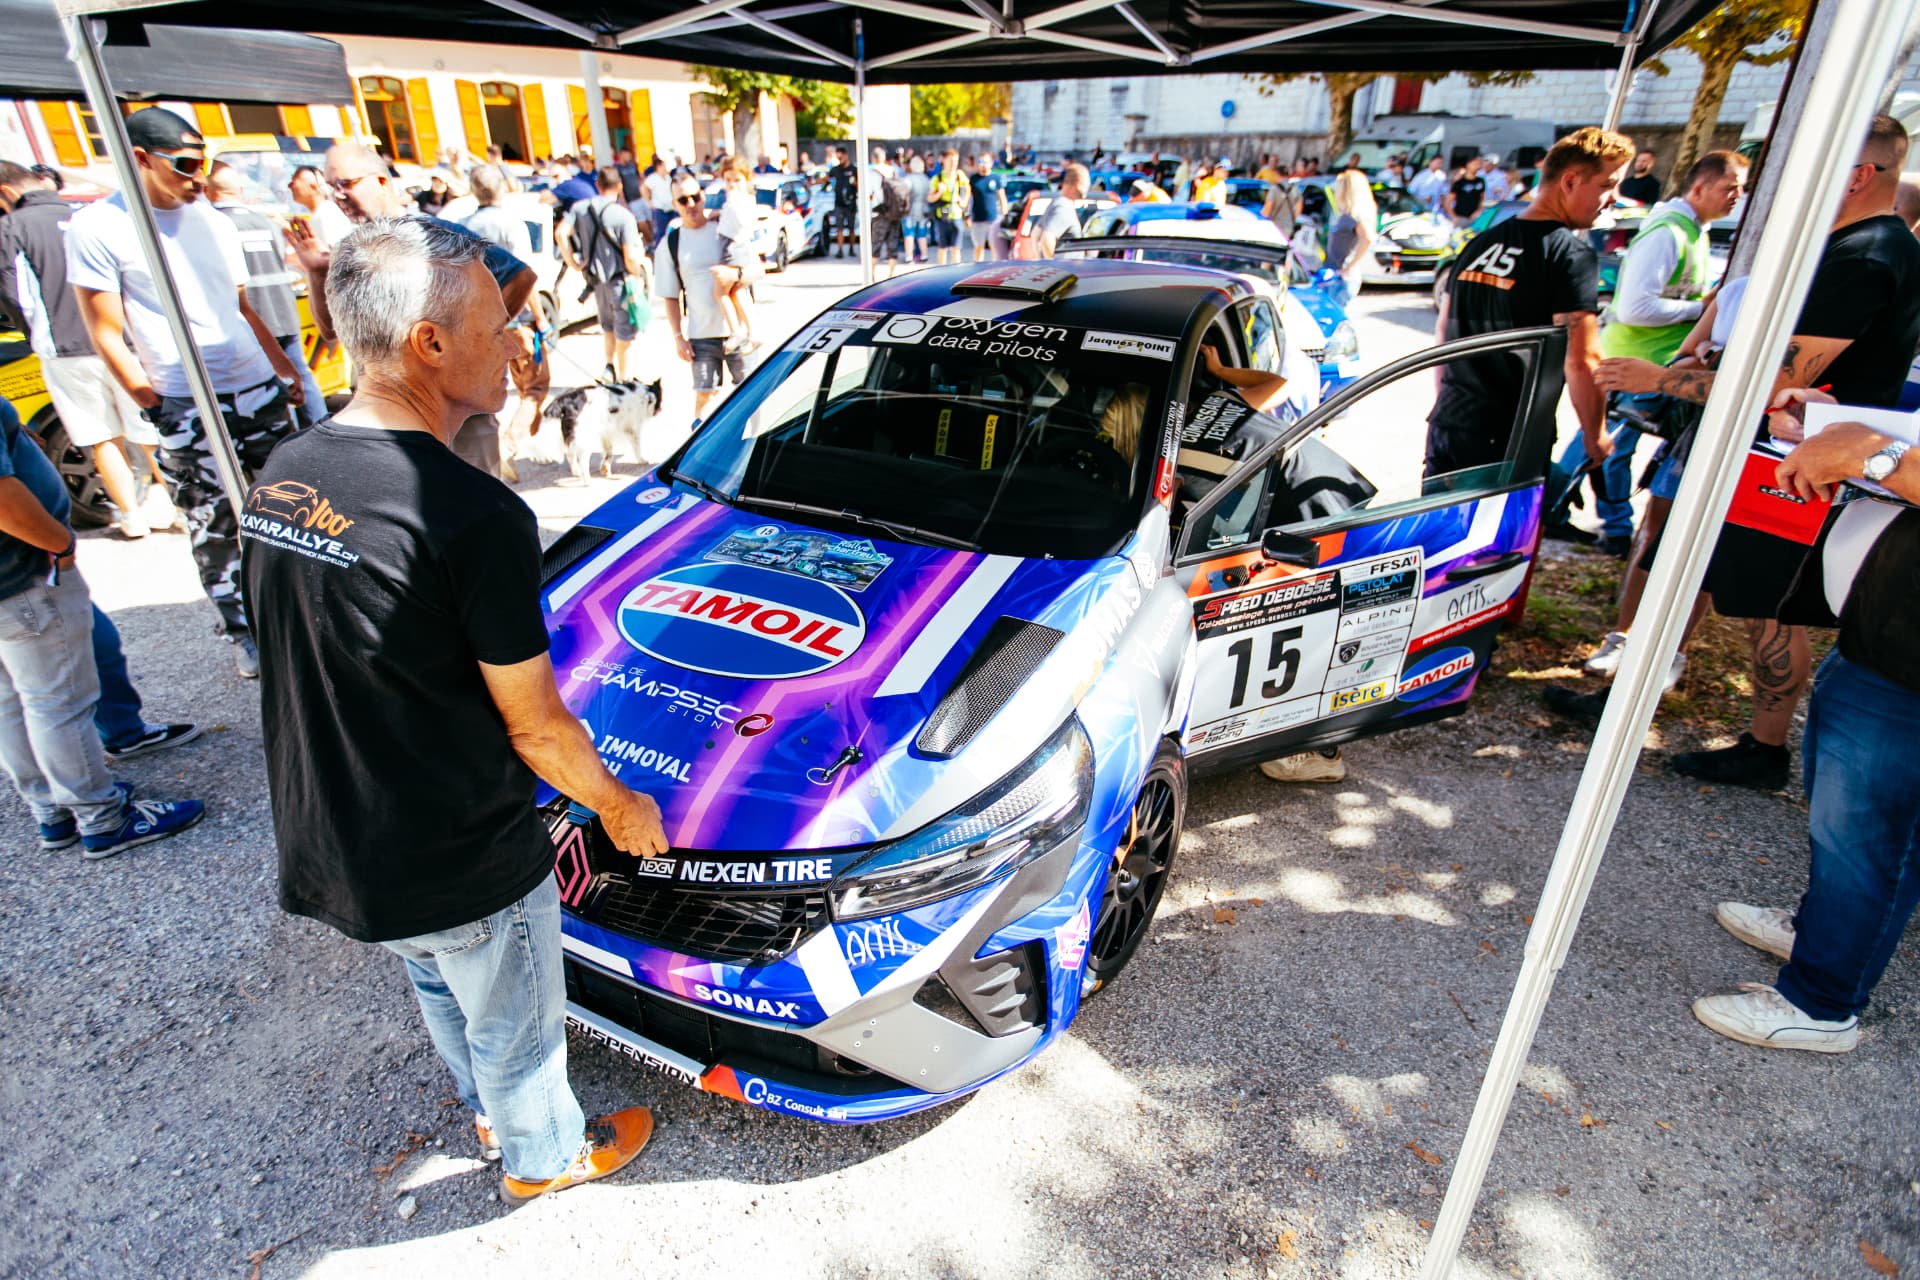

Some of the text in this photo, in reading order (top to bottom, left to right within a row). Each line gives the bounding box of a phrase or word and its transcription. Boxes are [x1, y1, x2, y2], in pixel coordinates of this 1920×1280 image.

[798, 328, 842, 350] 15
[944, 317, 1068, 341] oxygen
[929, 332, 1057, 361] data pilots
[1088, 336, 1172, 353] Jacques POINT
[1370, 558, 1411, 575] FFSA
[1349, 572, 1405, 595] PETOLAT
[1198, 593, 1264, 621] SPEED
[1263, 577, 1335, 608] DEBOSSE
[1294, 592, 1337, 609] peinture
[632, 583, 845, 657] TAMOIL
[1343, 603, 1415, 627] ALPINE
[580, 657, 647, 677] GARAGE DE
[1227, 624, 1304, 710] 15
[1397, 656, 1473, 694] TAMOIL
[570, 665, 742, 724] CHAMPSEC
[1333, 683, 1382, 708] isère
[667, 704, 724, 729] SION
[597, 734, 693, 783] IMMOVAL
[680, 858, 833, 883] NEXEN TIRE
[694, 984, 798, 1019] SONAX
[565, 1015, 697, 1087] SUSPENSION
[766, 1094, 782, 1107] BZ
[784, 1098, 825, 1117] Consult
